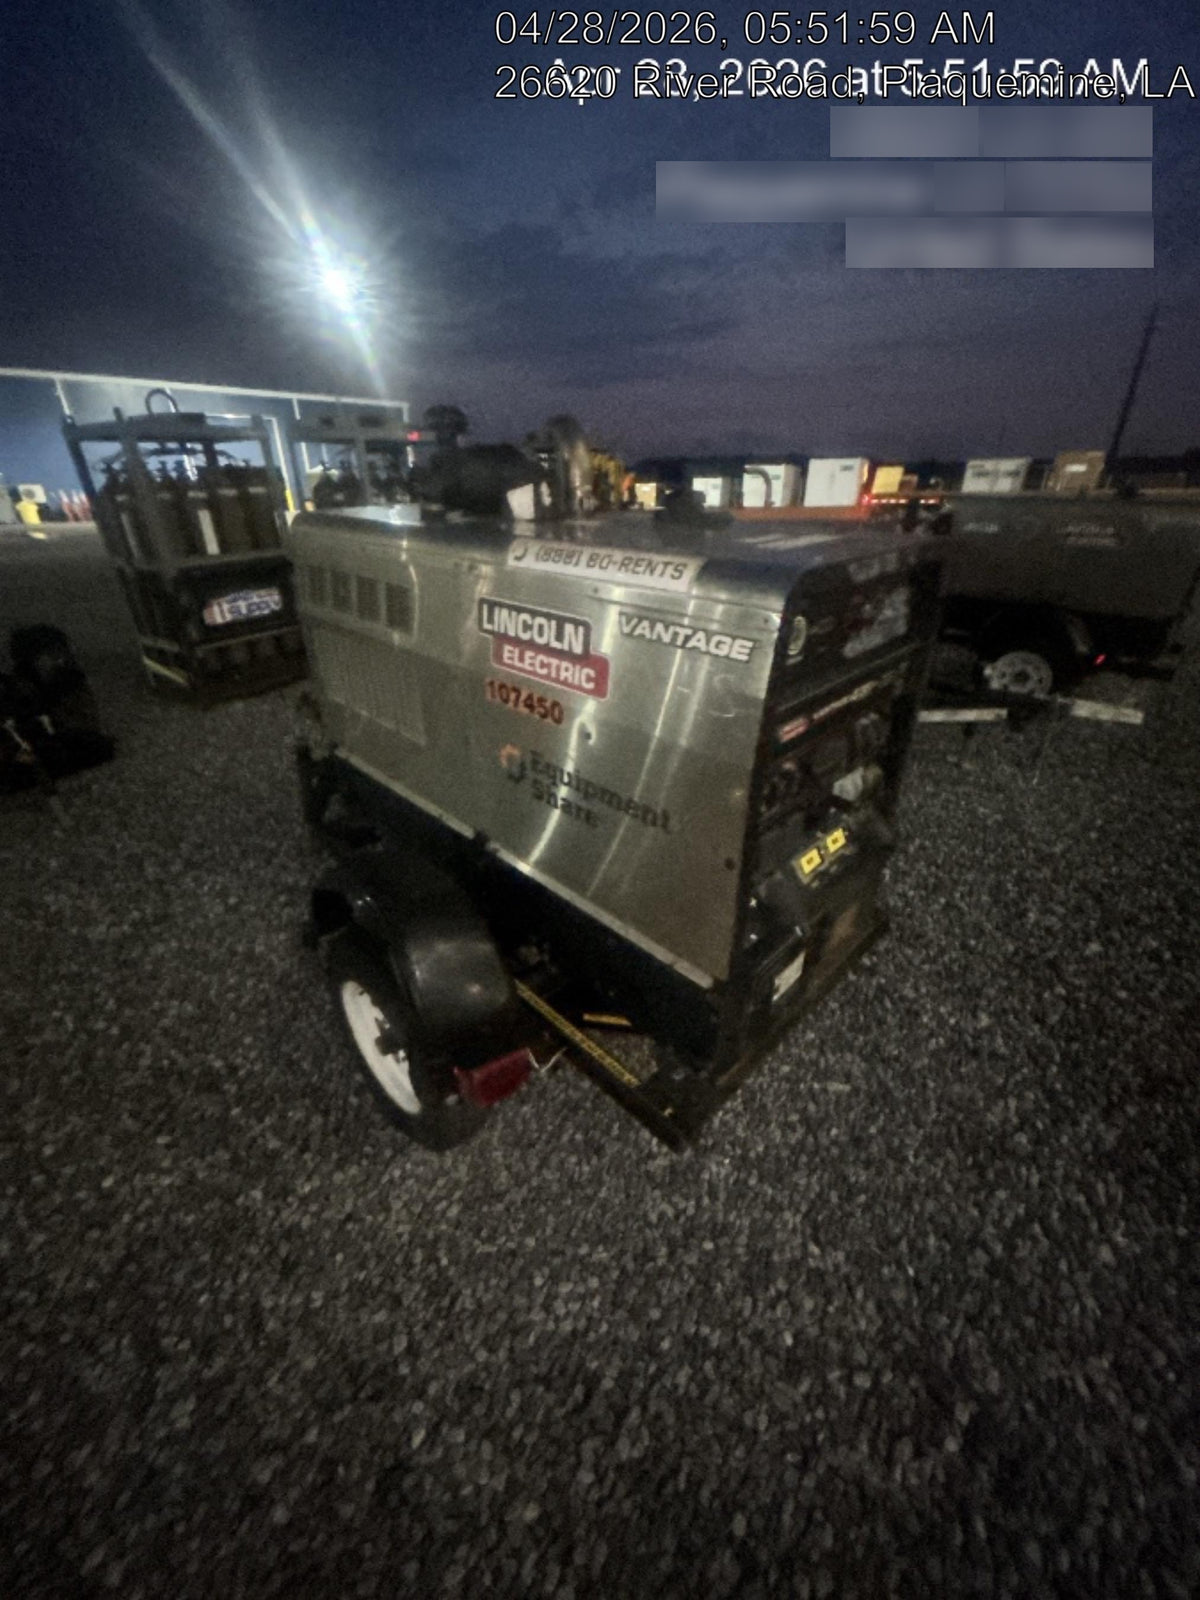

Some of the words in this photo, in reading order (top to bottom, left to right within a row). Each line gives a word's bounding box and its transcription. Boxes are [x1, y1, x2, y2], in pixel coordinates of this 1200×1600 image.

[482, 603, 585, 655] LINCOLN
[619, 614, 755, 662] VANTAGE
[502, 643, 597, 690] ELECTRIC
[485, 679, 565, 726] 107450
